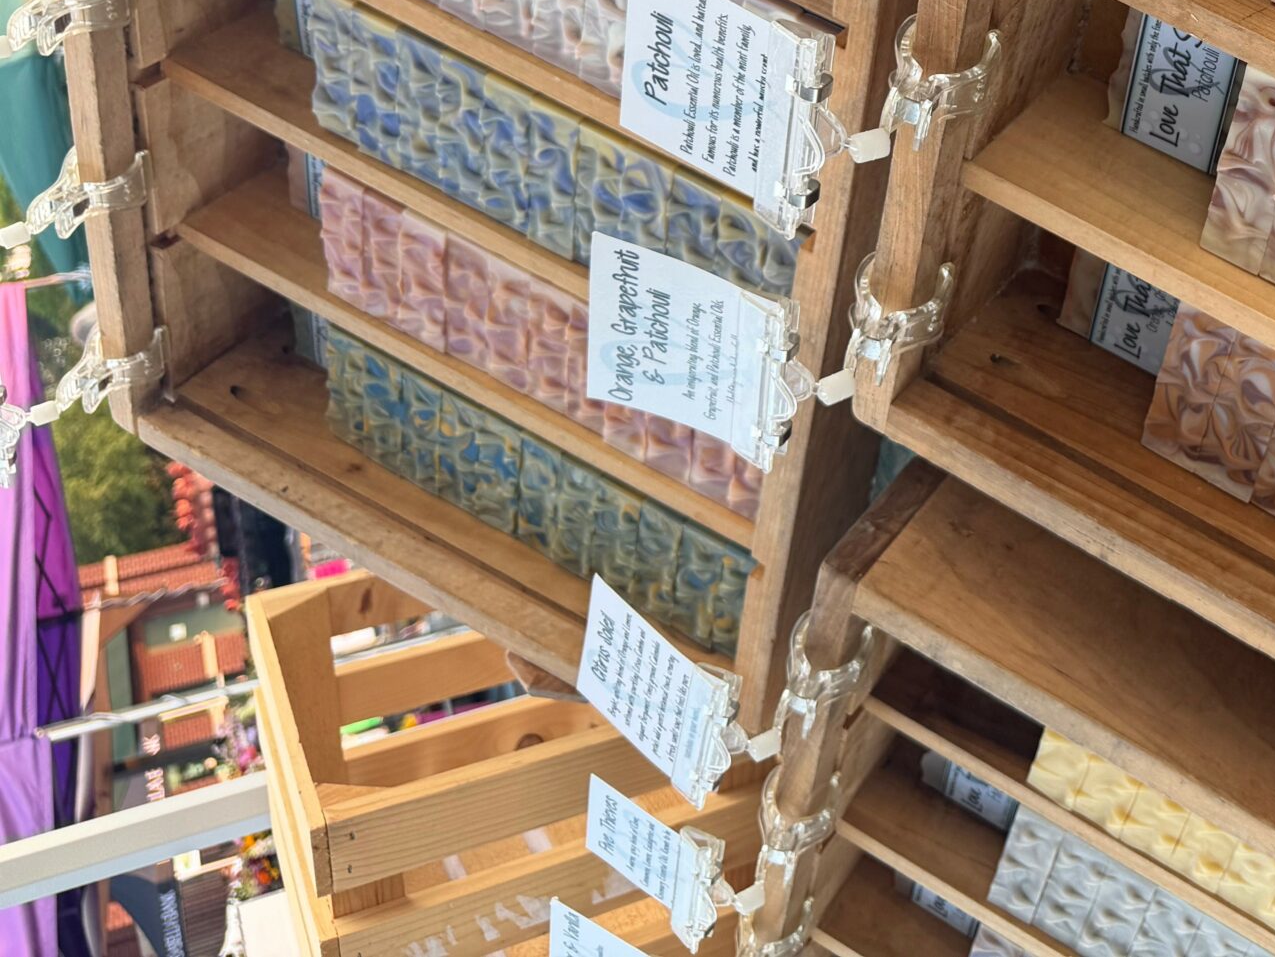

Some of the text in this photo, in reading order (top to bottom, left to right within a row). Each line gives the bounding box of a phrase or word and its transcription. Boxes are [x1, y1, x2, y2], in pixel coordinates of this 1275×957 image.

[1147, 40, 1161, 53] only
[1150, 31, 1160, 41] the
[644, 10, 674, 106] Patchouli
[691, 63, 701, 72] is
[710, 45, 725, 71] health
[736, 51, 748, 72] mint
[1145, 52, 1155, 64] with
[1158, 42, 1192, 98] That
[686, 70, 701, 84] Oil
[733, 72, 746, 86] the
[1191, 47, 1220, 103] Patchouli
[684, 83, 699, 119] Essential
[711, 73, 723, 110] numerous
[732, 83, 745, 96] of
[1138, 83, 1149, 97] small
[708, 110, 719, 121] its
[731, 95, 744, 128] member
[1128, 102, 1144, 134] Handcrafted
[680, 119, 696, 155] Patchouli
[705, 120, 718, 135] for
[730, 133, 739, 142] is
[1149, 105, 1180, 148] Love
[701, 136, 716, 164] Famous
[722, 141, 739, 177] Patchouli
[747, 157, 758, 173] and
[607, 249, 642, 402] Orange, Grapefruit
[642, 287, 671, 385] & Patchouli
[686, 326, 700, 336] of
[708, 313, 723, 343] Essential
[685, 334, 699, 353] blend
[1113, 321, 1141, 360] Love
[705, 343, 721, 374] Patchouli
[706, 372, 719, 386] and
[681, 391, 695, 400] An
[591, 645, 611, 682] Citrus
[599, 793, 618, 833] Thieves
